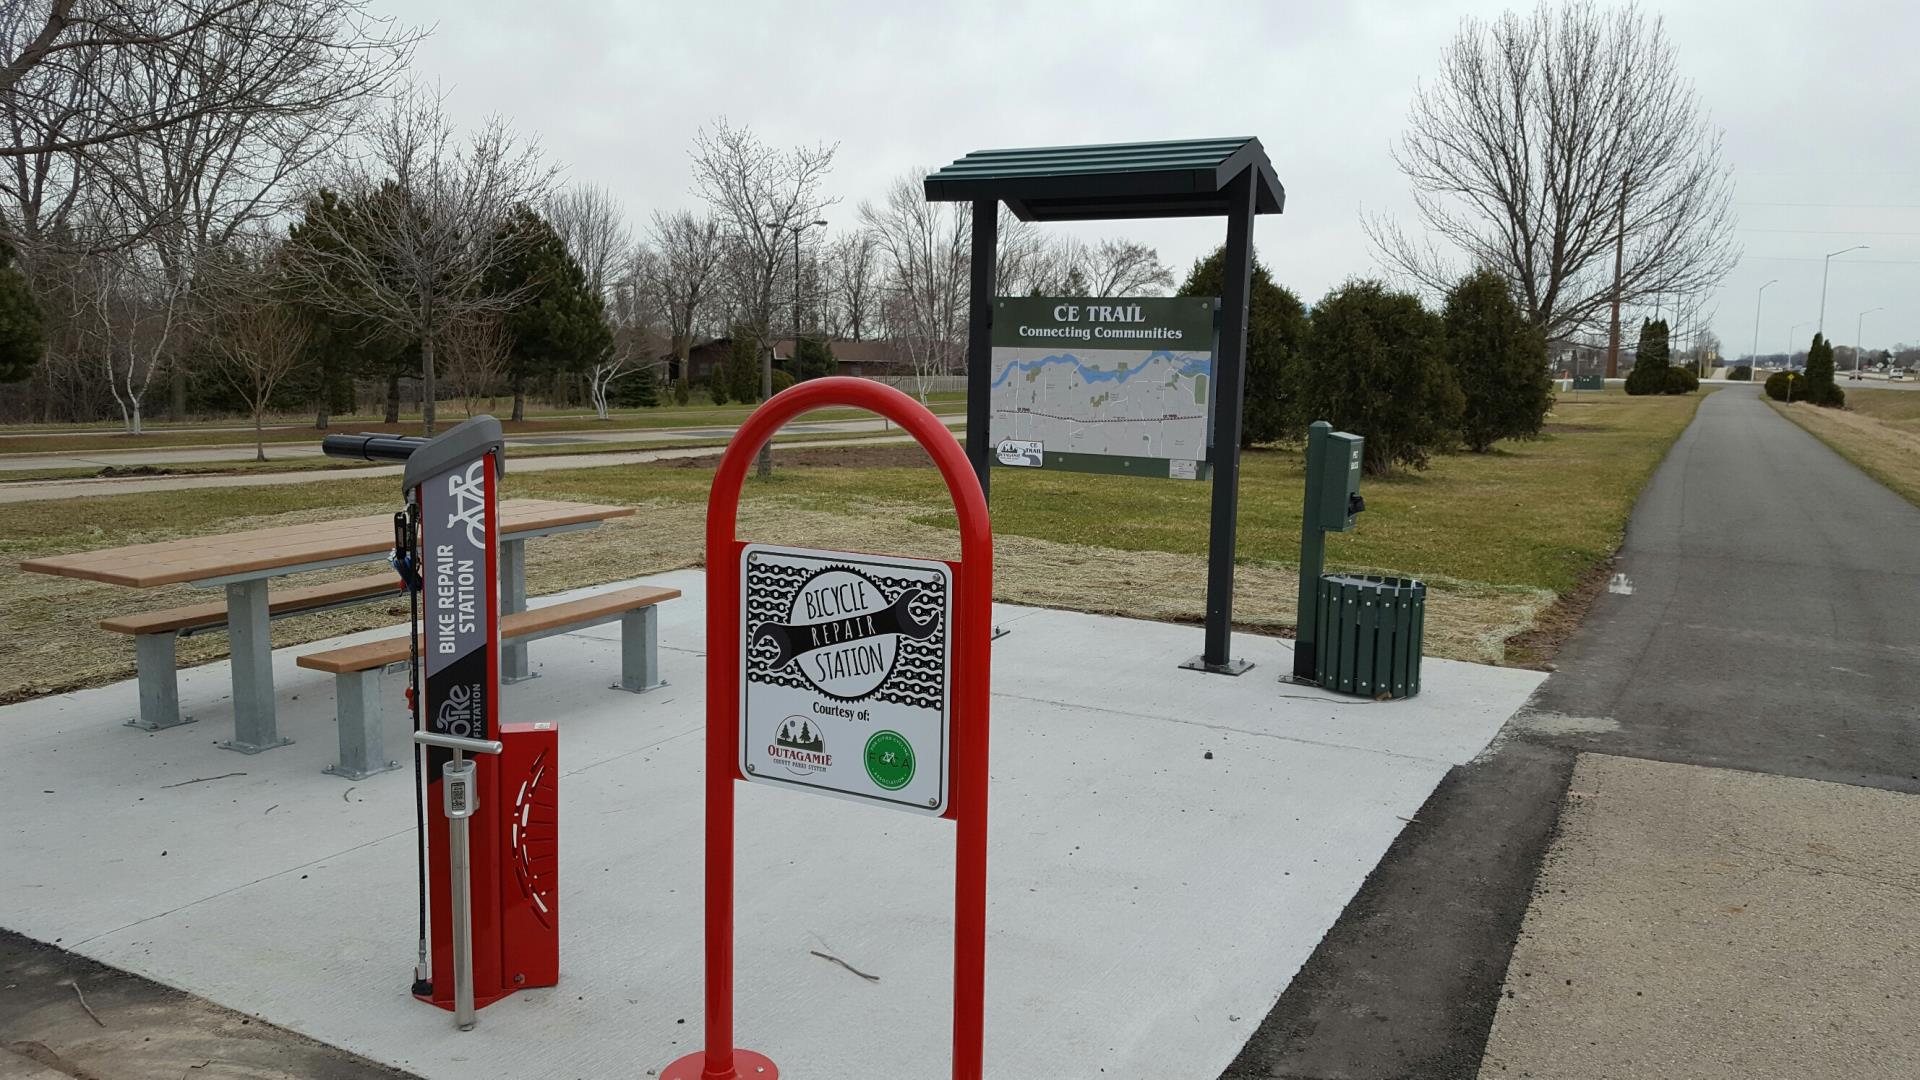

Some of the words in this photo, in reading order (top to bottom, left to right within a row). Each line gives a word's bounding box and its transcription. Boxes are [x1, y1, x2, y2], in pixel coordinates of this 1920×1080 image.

[1053, 305, 1080, 322] CE
[1086, 305, 1146, 323] TRAIL
[1019, 325, 1091, 341] Connecting
[1094, 326, 1183, 340] Communities
[437, 544, 454, 609] REPAIR
[458, 559, 475, 633] STATION
[804, 580, 869, 620] BICYCLE
[439, 613, 456, 654] BIKE
[810, 615, 876, 647] REPAIR
[816, 642, 884, 683] STATION
[472, 683, 482, 738] FIXTATION
[813, 702, 854, 722] Courtesy
[857, 709, 870, 722] of:
[767, 744, 833, 767] OUTAGAMIE
[808, 765, 827, 773] SYSTEM
